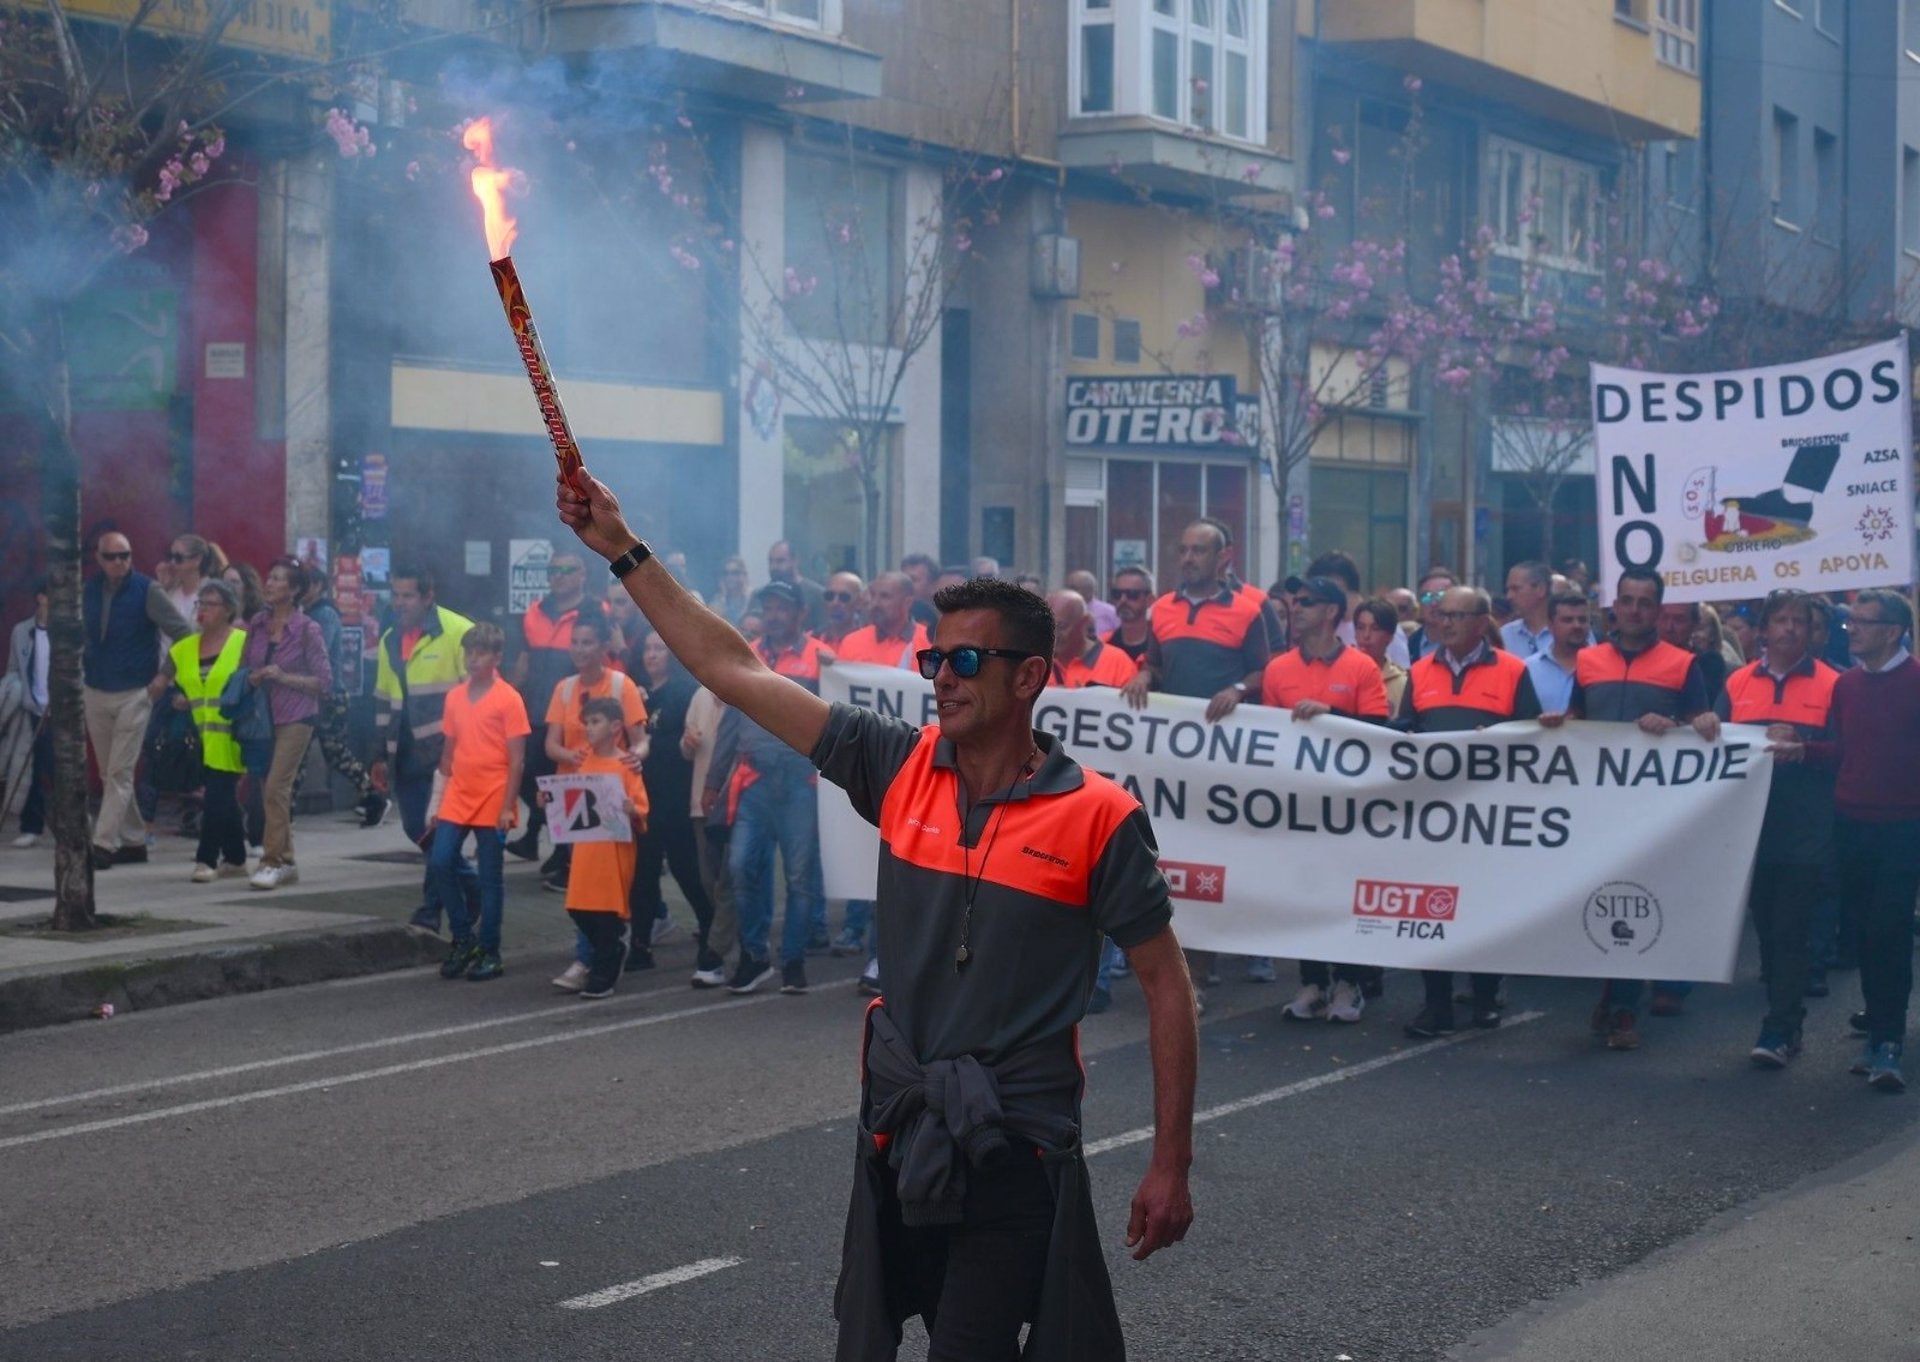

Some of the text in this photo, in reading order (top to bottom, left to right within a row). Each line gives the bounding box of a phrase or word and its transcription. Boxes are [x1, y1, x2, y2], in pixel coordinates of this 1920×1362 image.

[1596, 360, 1900, 423] DESPIDOS
[1066, 406, 1226, 444] OTERO
[1781, 432, 1850, 448] BRIDGESTONE
[1863, 448, 1900, 464] AZSA
[1847, 479, 1897, 497] SNIACE
[1726, 539, 1783, 553] OBRERO
[1774, 560, 1801, 578] OS
[1818, 552, 1889, 574] APOYA
[848, 685, 904, 719] EN
[1294, 735, 1371, 777] NO
[1387, 740, 1580, 786] SOBRA
[1596, 742, 1751, 787] NADIE
[1206, 783, 1572, 849] SOLUCIONES
[1357, 883, 1425, 915] UGT
[1595, 894, 1650, 918] SITB
[1396, 919, 1445, 940] FICA
